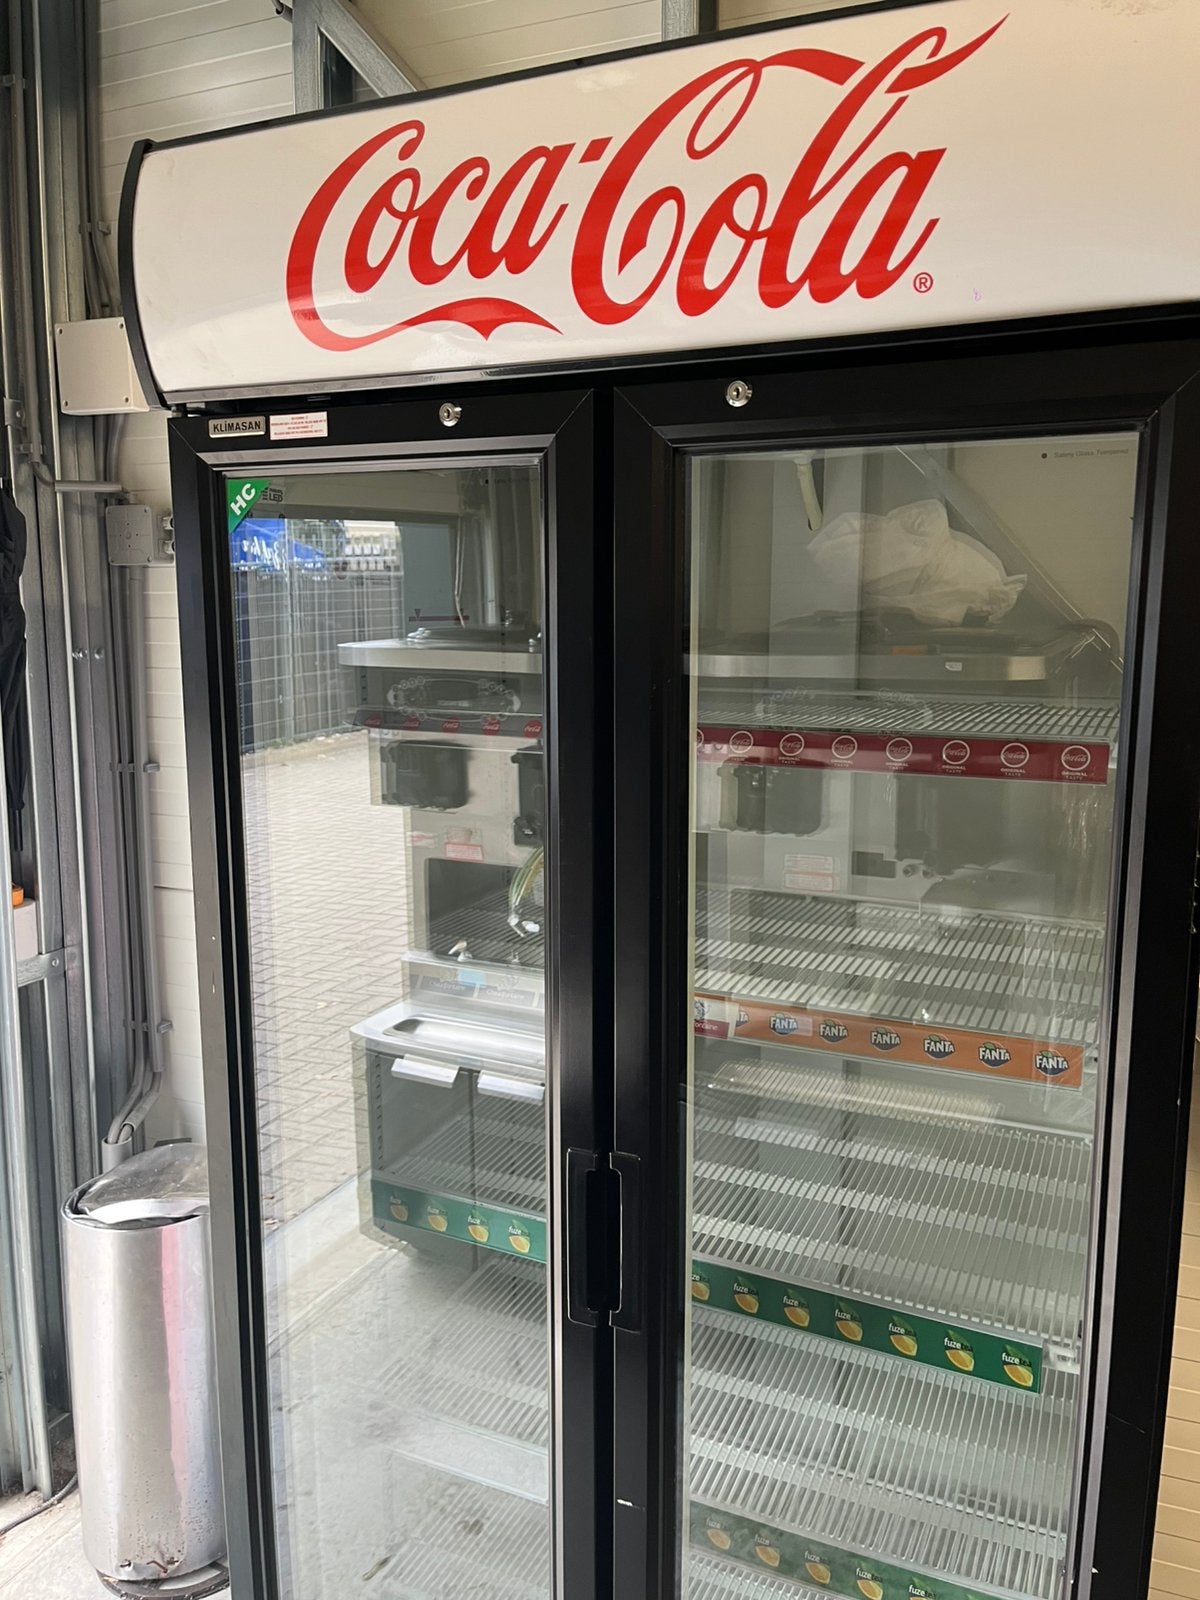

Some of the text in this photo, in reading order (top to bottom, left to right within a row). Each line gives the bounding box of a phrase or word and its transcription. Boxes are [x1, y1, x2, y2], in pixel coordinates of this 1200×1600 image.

[286, 12, 1010, 352] Coca-Cola
[230, 483, 256, 516] HC
[770, 1016, 1069, 1070] FANTA FANTA FANTA FANTA FANTA FANTA
